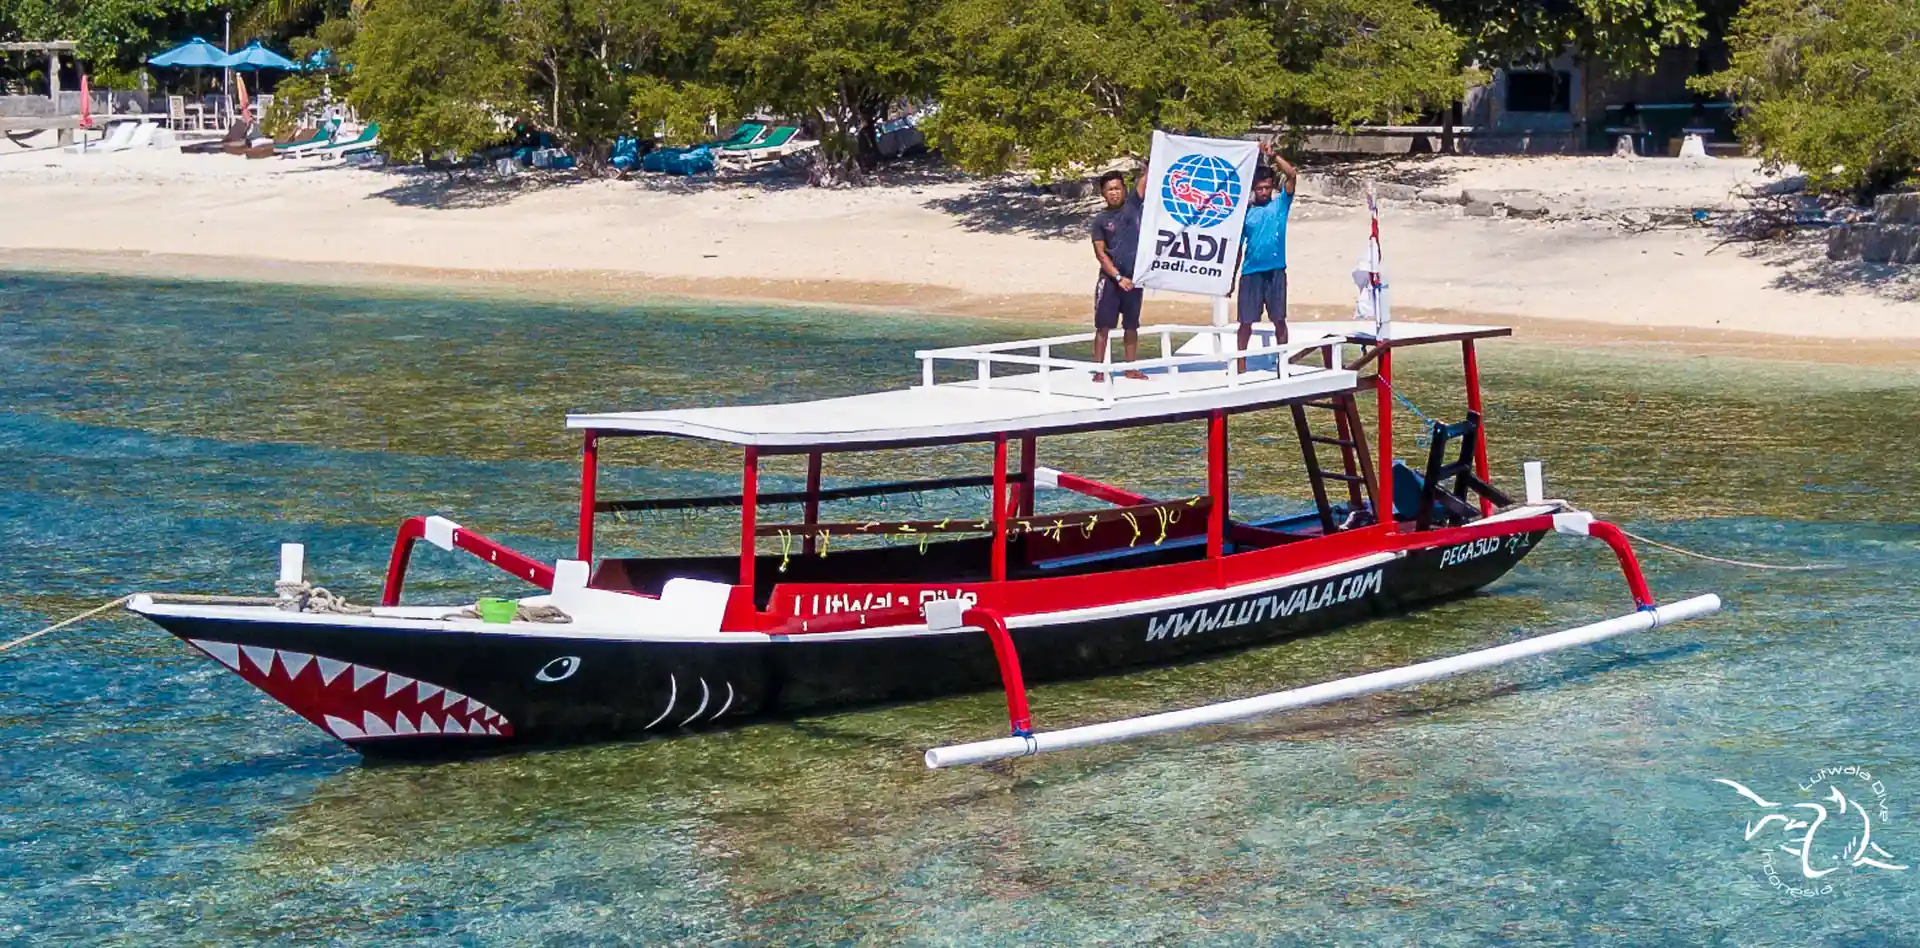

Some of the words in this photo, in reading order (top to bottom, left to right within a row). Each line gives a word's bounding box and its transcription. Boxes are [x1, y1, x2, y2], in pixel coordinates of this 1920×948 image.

[1156, 229, 1228, 264] PADI
[1150, 260, 1222, 278] padi.com
[1439, 536, 1500, 570] PEGASUS
[1146, 568, 1383, 642] WWW.LUTWALA.COM
